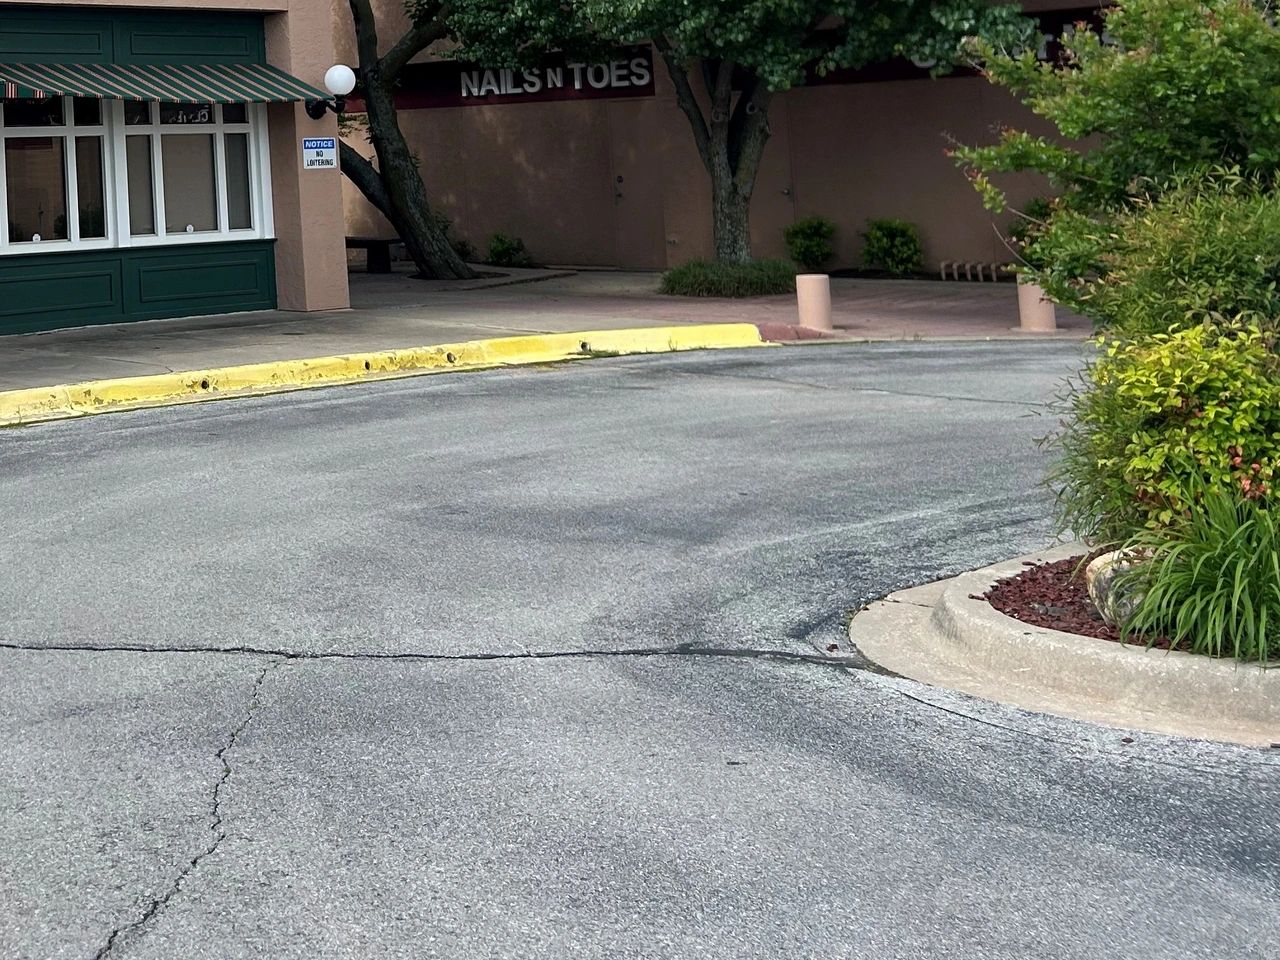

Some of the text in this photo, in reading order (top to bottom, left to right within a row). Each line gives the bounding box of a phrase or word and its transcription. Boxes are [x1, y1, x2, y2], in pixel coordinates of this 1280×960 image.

[460, 58, 651, 97] NAILS N TOES
